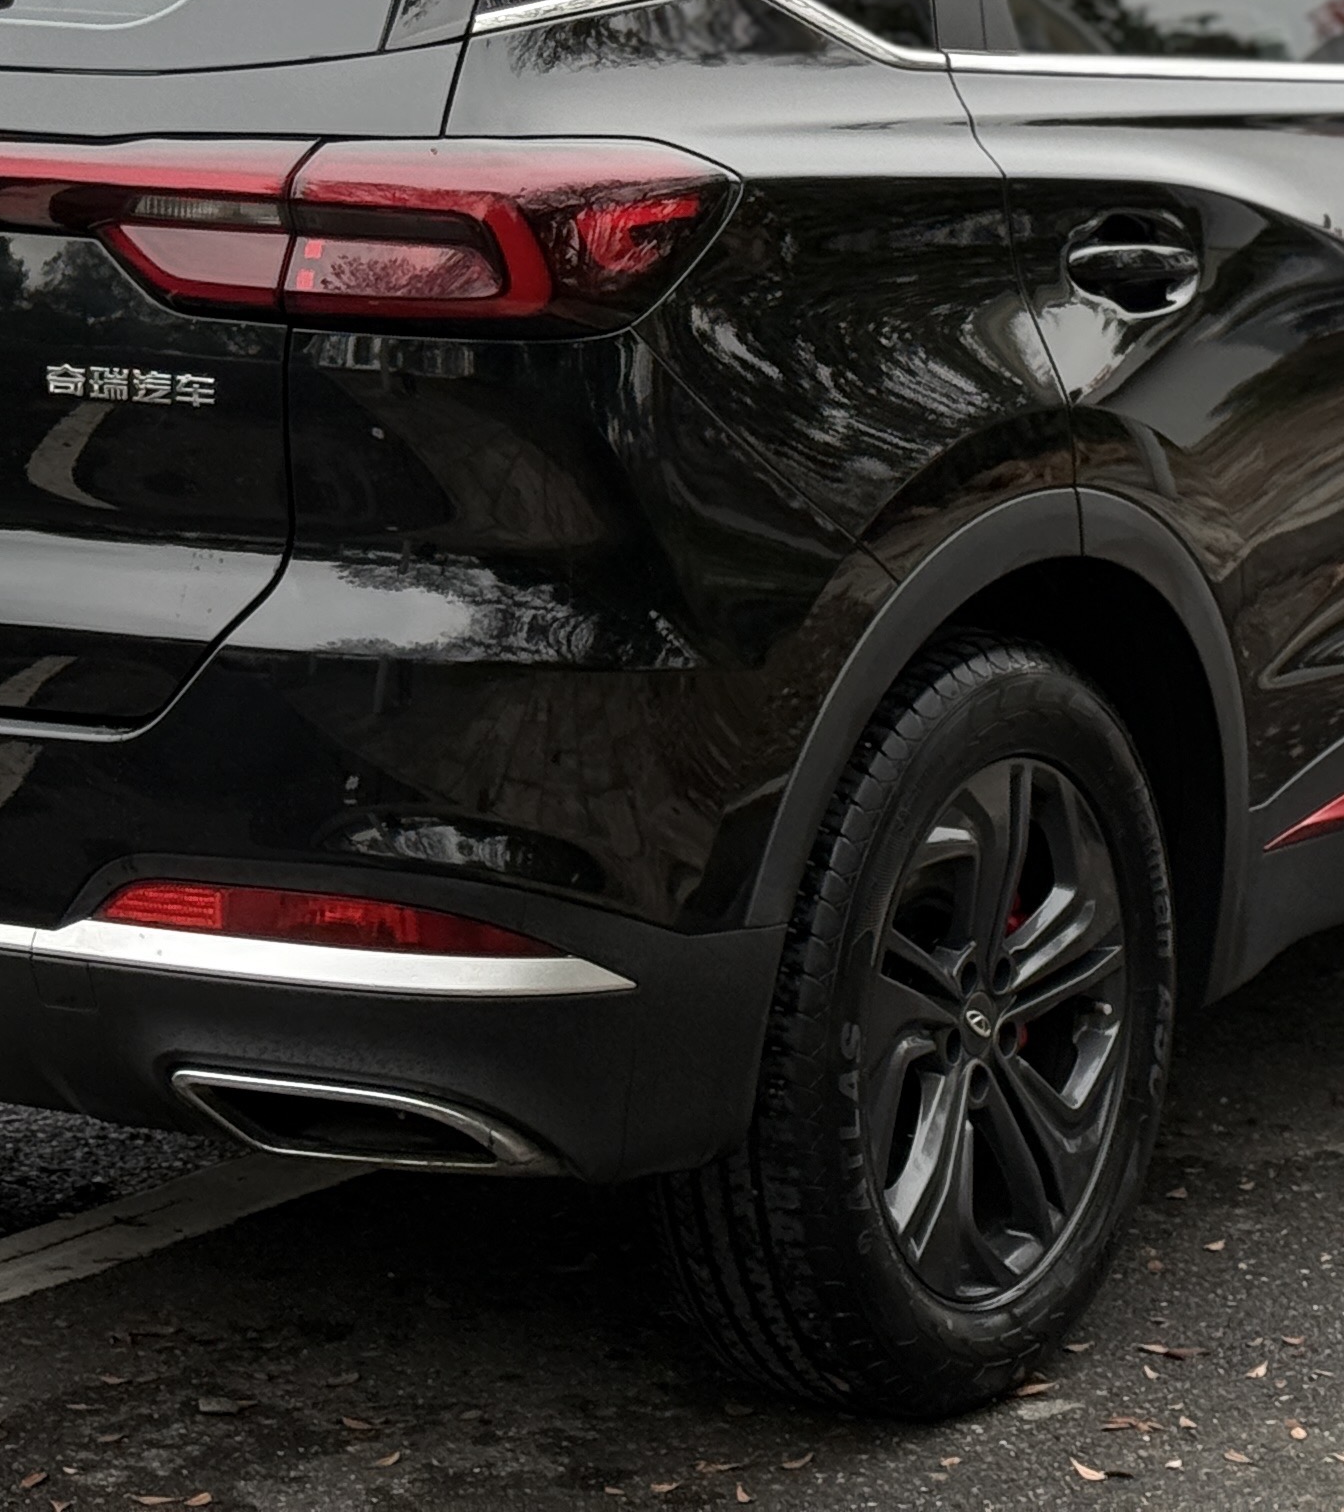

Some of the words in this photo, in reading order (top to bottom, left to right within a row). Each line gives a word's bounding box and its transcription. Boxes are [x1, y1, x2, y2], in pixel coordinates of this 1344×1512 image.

[46, 363, 216, 407] 奇瑞汽车
[838, 1019, 873, 1211] ATLAS
